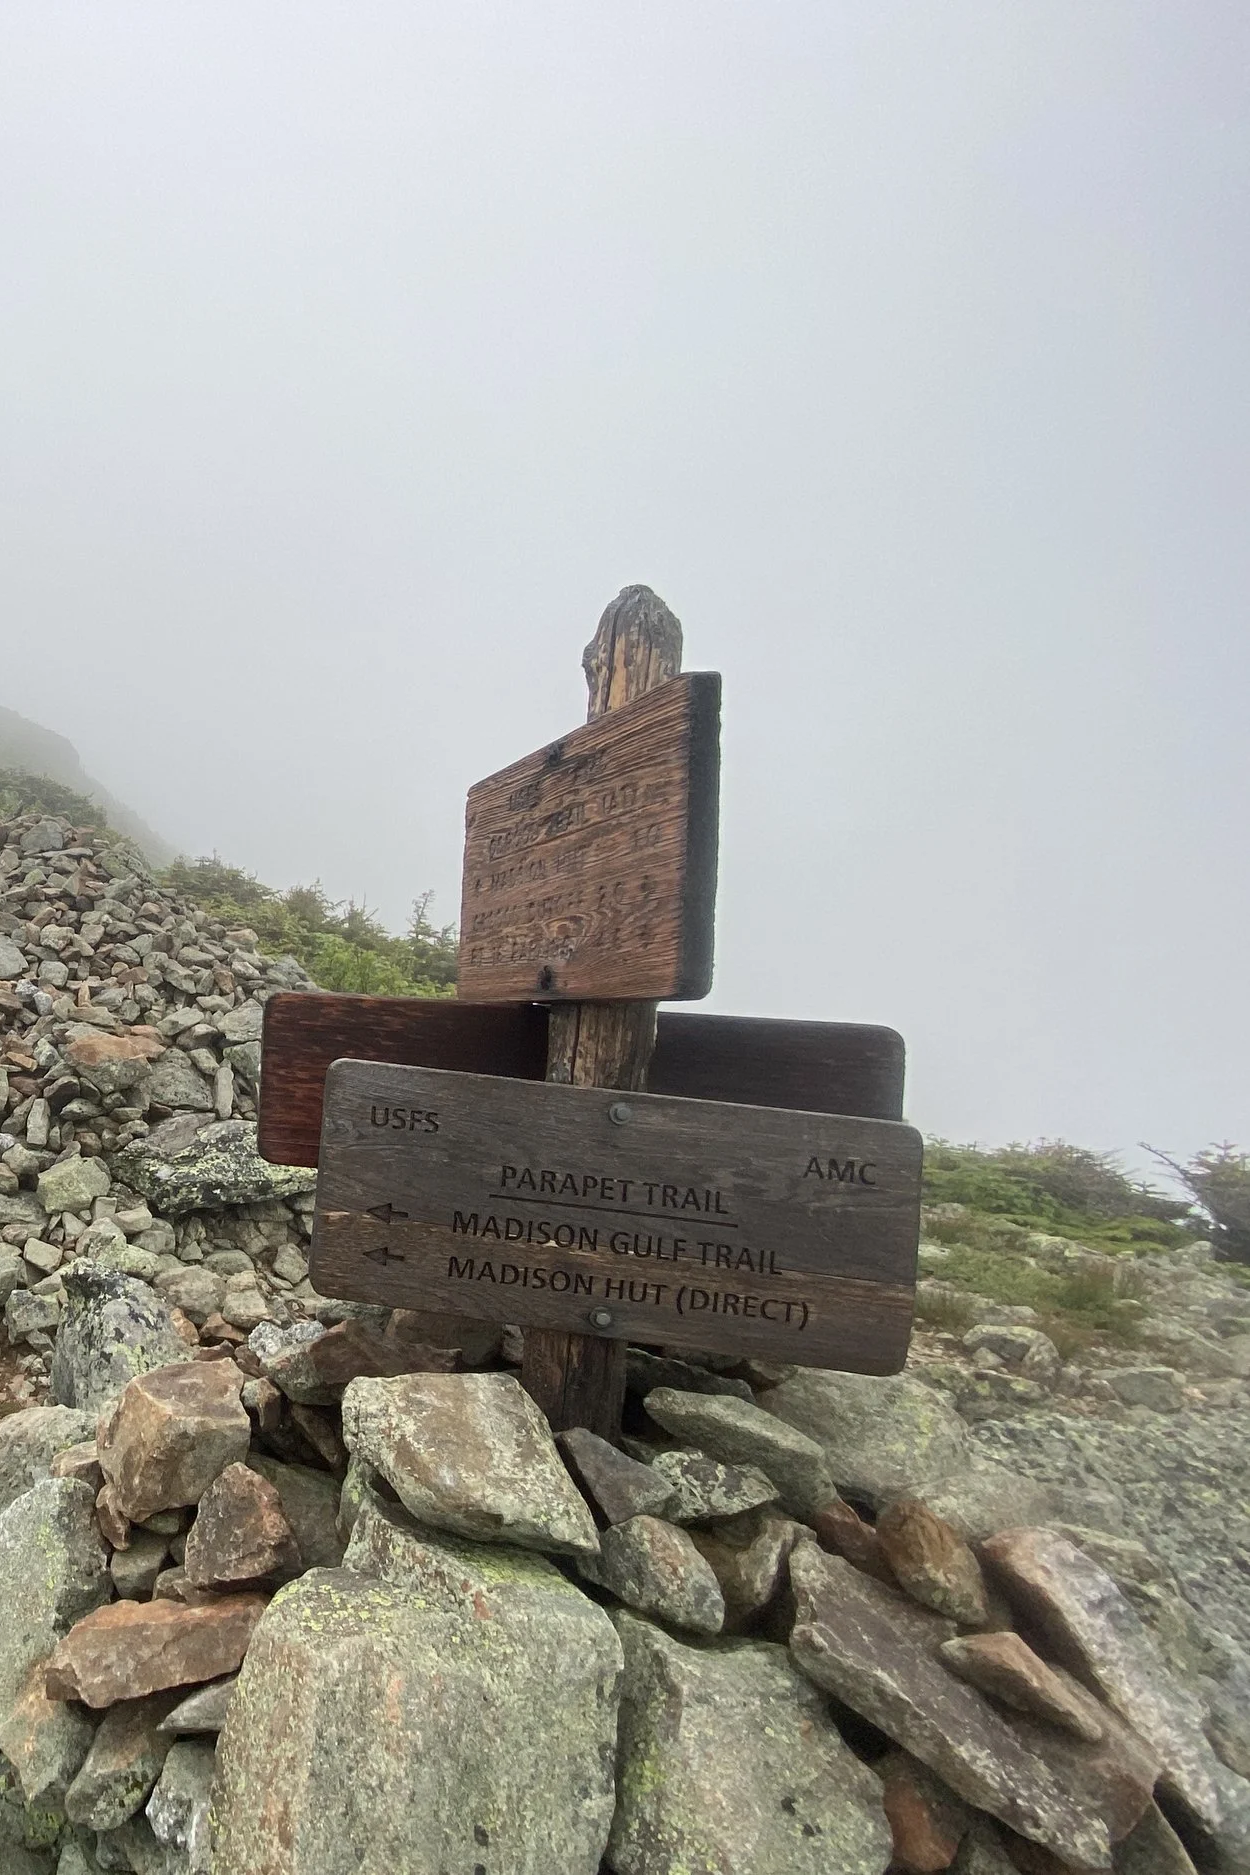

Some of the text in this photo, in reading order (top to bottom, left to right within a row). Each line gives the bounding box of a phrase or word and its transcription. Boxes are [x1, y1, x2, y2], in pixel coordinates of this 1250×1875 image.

[370, 1105, 441, 1134] USFS
[500, 1165, 729, 1215] PARAPET TRAIL
[803, 1156, 877, 1187] AMC
[452, 1211, 783, 1276] MADISON GULF TRAIL
[447, 1256, 810, 1331] MADISON HUT (DIRECT)
